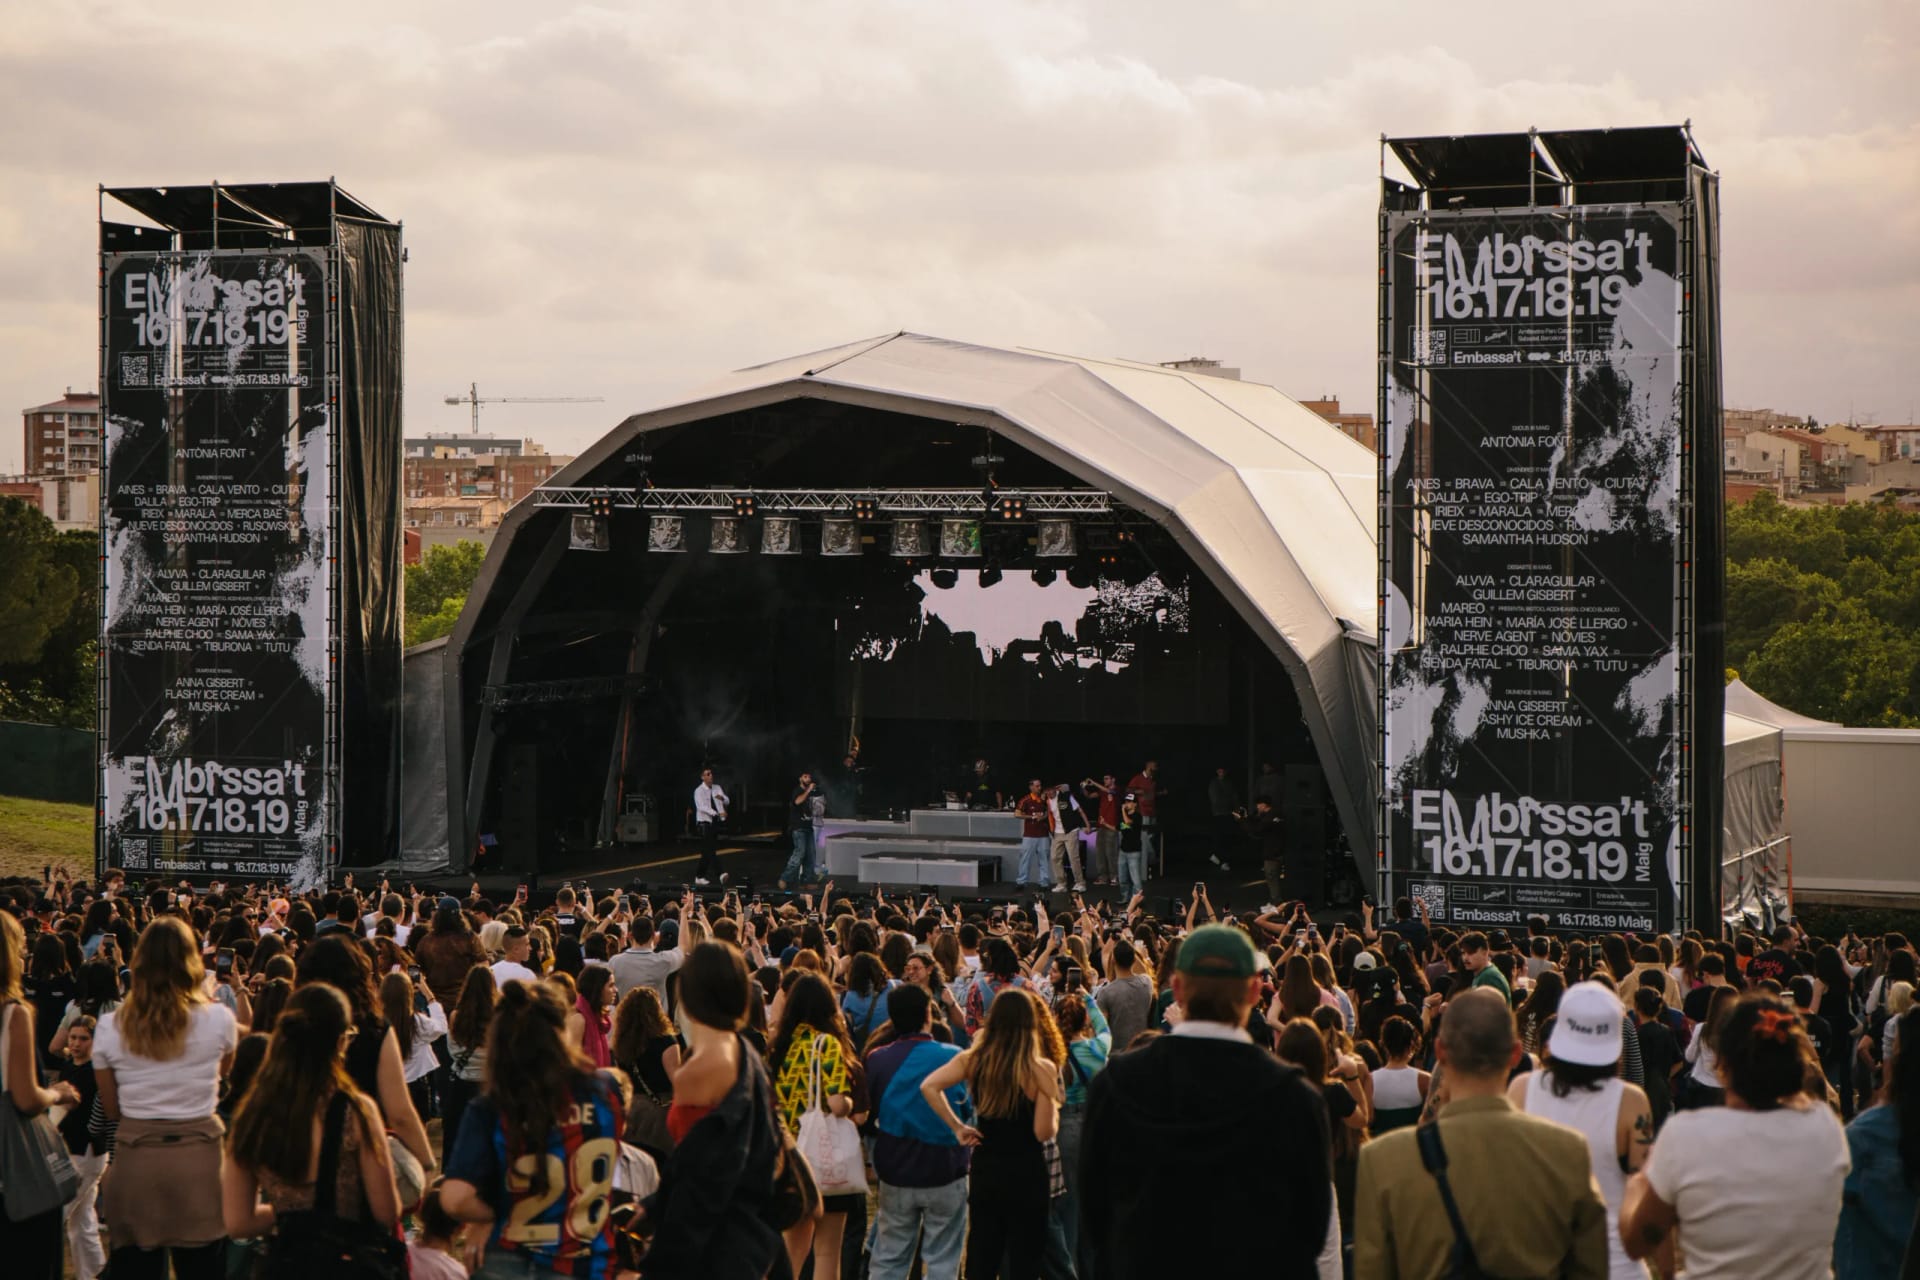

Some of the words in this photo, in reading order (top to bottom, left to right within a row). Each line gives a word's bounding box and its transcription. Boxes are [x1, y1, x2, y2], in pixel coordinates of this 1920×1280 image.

[1454, 350, 1522, 364] Embassa't
[1480, 435, 1536, 448] ANTÒNIA
[1538, 435, 1572, 448] FONT
[175, 447, 219, 459] ANTÒNIA
[219, 448, 246, 459] FONT
[117, 485, 145, 494] AINES
[155, 485, 187, 494] BRAVA
[198, 485, 225, 494] CALA
[227, 485, 260, 494] VENTO
[1455, 478, 1495, 489] BRAVA
[1510, 478, 1544, 489] CALA
[134, 497, 168, 507] DALILA
[178, 497, 221, 507] EGO-TRIP
[1427, 492, 1469, 503] DALILA
[1484, 492, 1538, 503] EGO-TRIP
[174, 509, 216, 519] MARALA
[227, 509, 261, 519] MERCA
[263, 509, 282, 519] BAE
[1478, 506, 1532, 517] MARALA
[128, 521, 159, 531] NUEVE
[159, 521, 233, 531] DESCONOCIDOS
[1458, 519, 1554, 531] DESCONOCIDOS
[163, 533, 218, 543] SAMANTHA
[219, 533, 260, 543] HUDSON
[1462, 534, 1533, 545] SAMANTHA
[1536, 534, 1589, 545] HUDSON
[157, 570, 188, 579] ALVVA
[198, 570, 266, 579] CLARAGUILAR
[171, 581, 211, 591] GUILLEM
[211, 581, 251, 591] GISBERT
[1456, 575, 1495, 586] ALVVA
[1508, 575, 1595, 587] CLARAGUILAR
[145, 593, 181, 603] MAREO
[1473, 589, 1524, 600] GUILLEM
[1526, 589, 1576, 601] GISBERT
[132, 604, 164, 615] MARIA
[165, 605, 186, 615] HEIN
[1441, 602, 1485, 614] MAREO
[156, 617, 187, 627] NERVE
[187, 617, 220, 627] AGENT
[1425, 616, 1463, 627] MARIA
[1465, 616, 1492, 627] HEIN
[1506, 614, 1545, 628] MARÍA
[1549, 614, 1578, 628] JOSÉ
[1579, 617, 1627, 629] LLERGO
[145, 629, 184, 639] RALPHIE
[185, 629, 214, 639] CHOO
[224, 630, 254, 640] SAMA
[255, 631, 276, 640] YAX
[1454, 631, 1493, 642] NERVE
[1495, 631, 1536, 643] AGENT
[1551, 629, 1596, 643] NÒVIES
[132, 640, 163, 650] SENDA
[164, 640, 193, 651] FATAL
[204, 641, 252, 652] TIBURONA
[264, 642, 290, 653] TUTU
[1440, 644, 1489, 655] RALPHIE
[1491, 644, 1528, 655] CHOO
[1542, 645, 1580, 657] SAMA
[1584, 646, 1608, 657] YAX
[1465, 657, 1501, 669] FATAL
[1516, 659, 1578, 671] TIBURONA
[1593, 660, 1628, 672] TUTU
[176, 678, 204, 688] ANNA
[205, 678, 245, 688] GISBERT
[165, 690, 202, 700] FLASHY
[203, 690, 219, 700] ICE
[219, 690, 255, 700] CREAM
[188, 702, 230, 712] MUSHKA
[1518, 701, 1568, 713] GISBERT
[1515, 714, 1535, 726] ICE
[1537, 715, 1581, 727] CREAM
[1497, 728, 1550, 740] MUSHKA
[133, 797, 290, 834] 16.17.18.19
[294, 800, 308, 834] Maig
[1424, 835, 1628, 882] 16.17.18.19
[1635, 842, 1653, 882] Maig
[154, 858, 207, 871] Embassa't
[234, 861, 280, 874] 16.17.18.19
[1453, 907, 1521, 922] Embassa't
[1557, 912, 1617, 927] 16.17.18.19
[1618, 916, 1653, 931] Maig
[504, 1138, 617, 1245] 28
